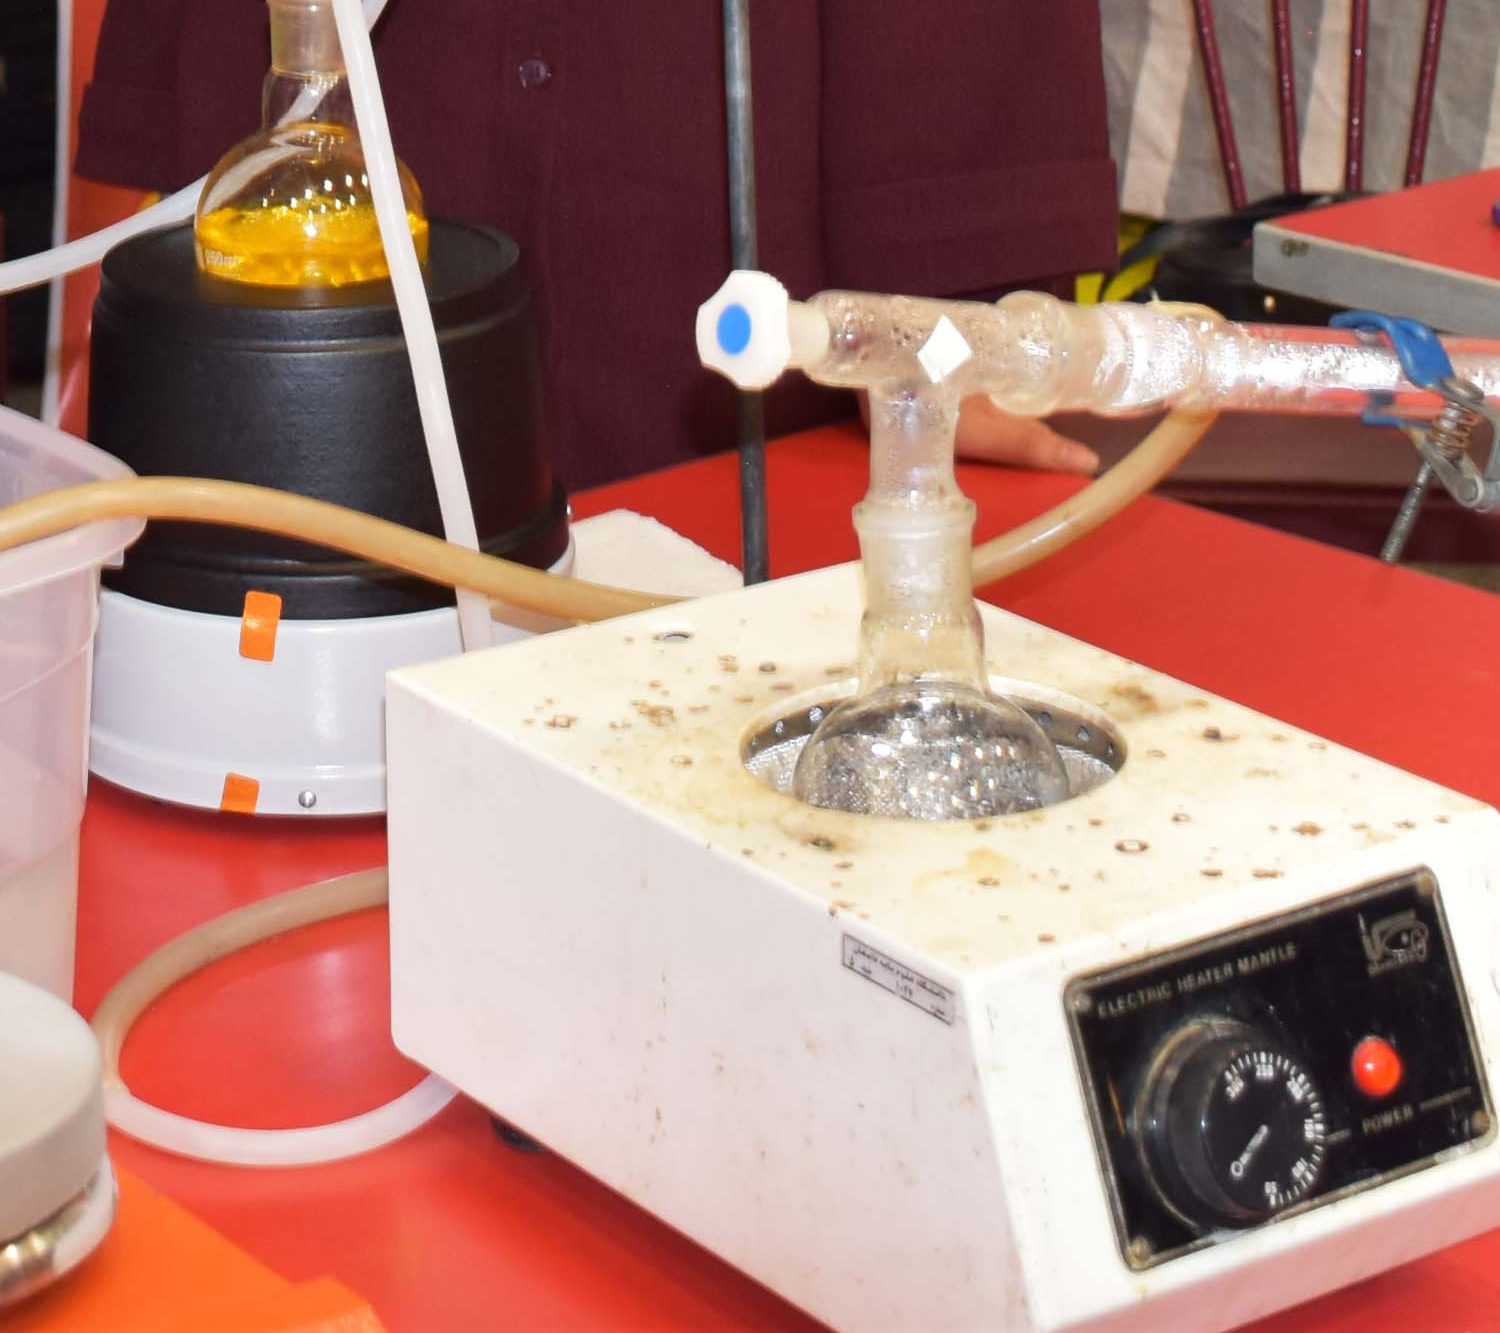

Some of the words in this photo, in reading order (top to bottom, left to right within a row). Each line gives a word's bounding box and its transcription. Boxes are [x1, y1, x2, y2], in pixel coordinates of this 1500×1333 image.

[1098, 982, 1173, 1018] ELECTRIC
[1177, 960, 1232, 993] HEATER
[1237, 941, 1298, 974] MANTLE
[1362, 1106, 1413, 1134] POWER
